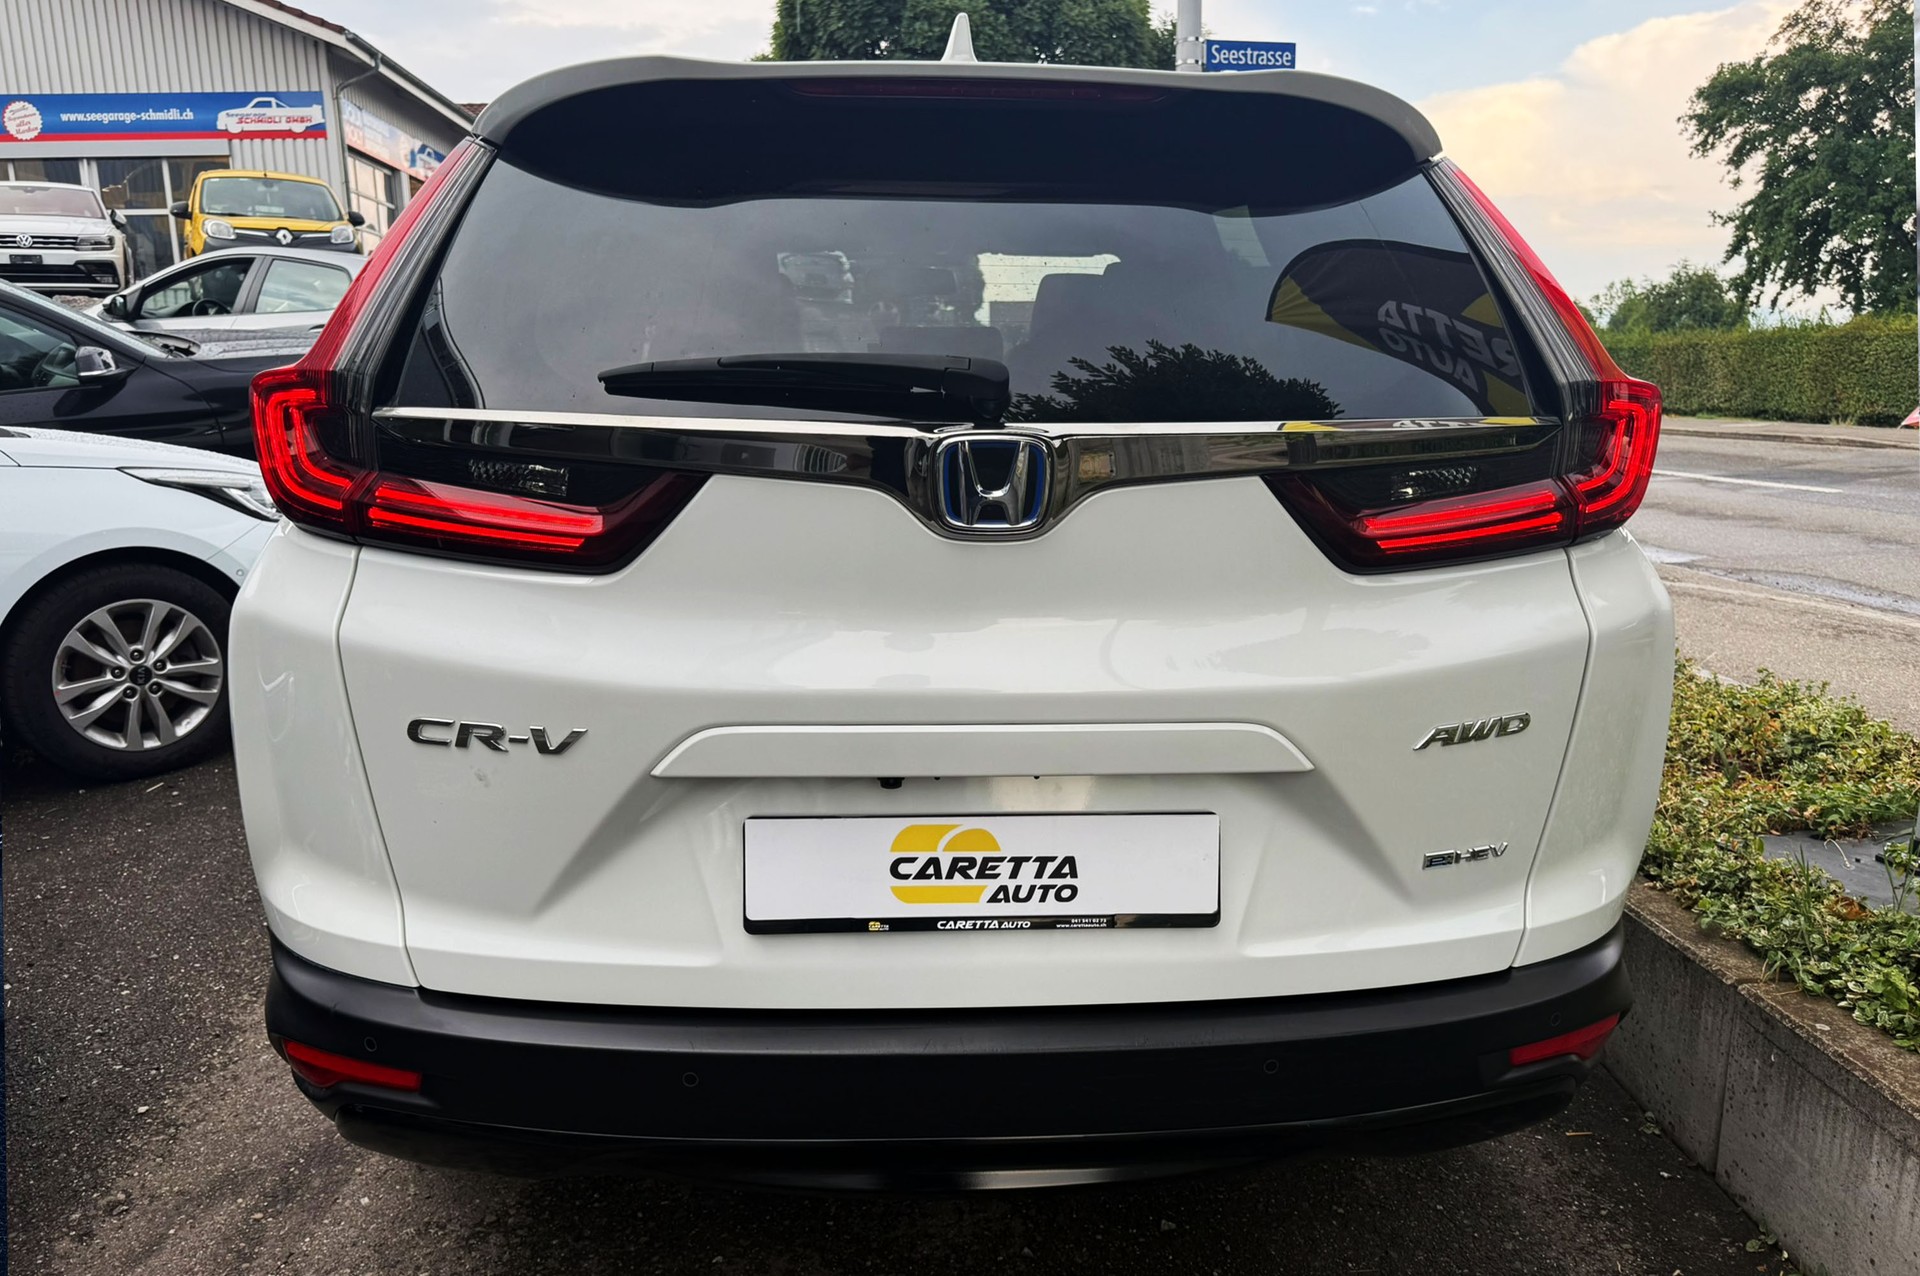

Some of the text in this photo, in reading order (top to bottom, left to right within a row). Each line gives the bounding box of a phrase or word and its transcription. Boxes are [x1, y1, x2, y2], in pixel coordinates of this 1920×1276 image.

[1211, 44, 1292, 66] Seestrasse
[60, 108, 194, 124] www.seegarage-schmidli.ch
[406, 717, 588, 754] CR-V
[1412, 711, 1531, 751] AWD
[889, 856, 1079, 880] CARETTA
[986, 884, 1079, 903] AUTO
[936, 920, 1031, 930] CARETTA AUTO
